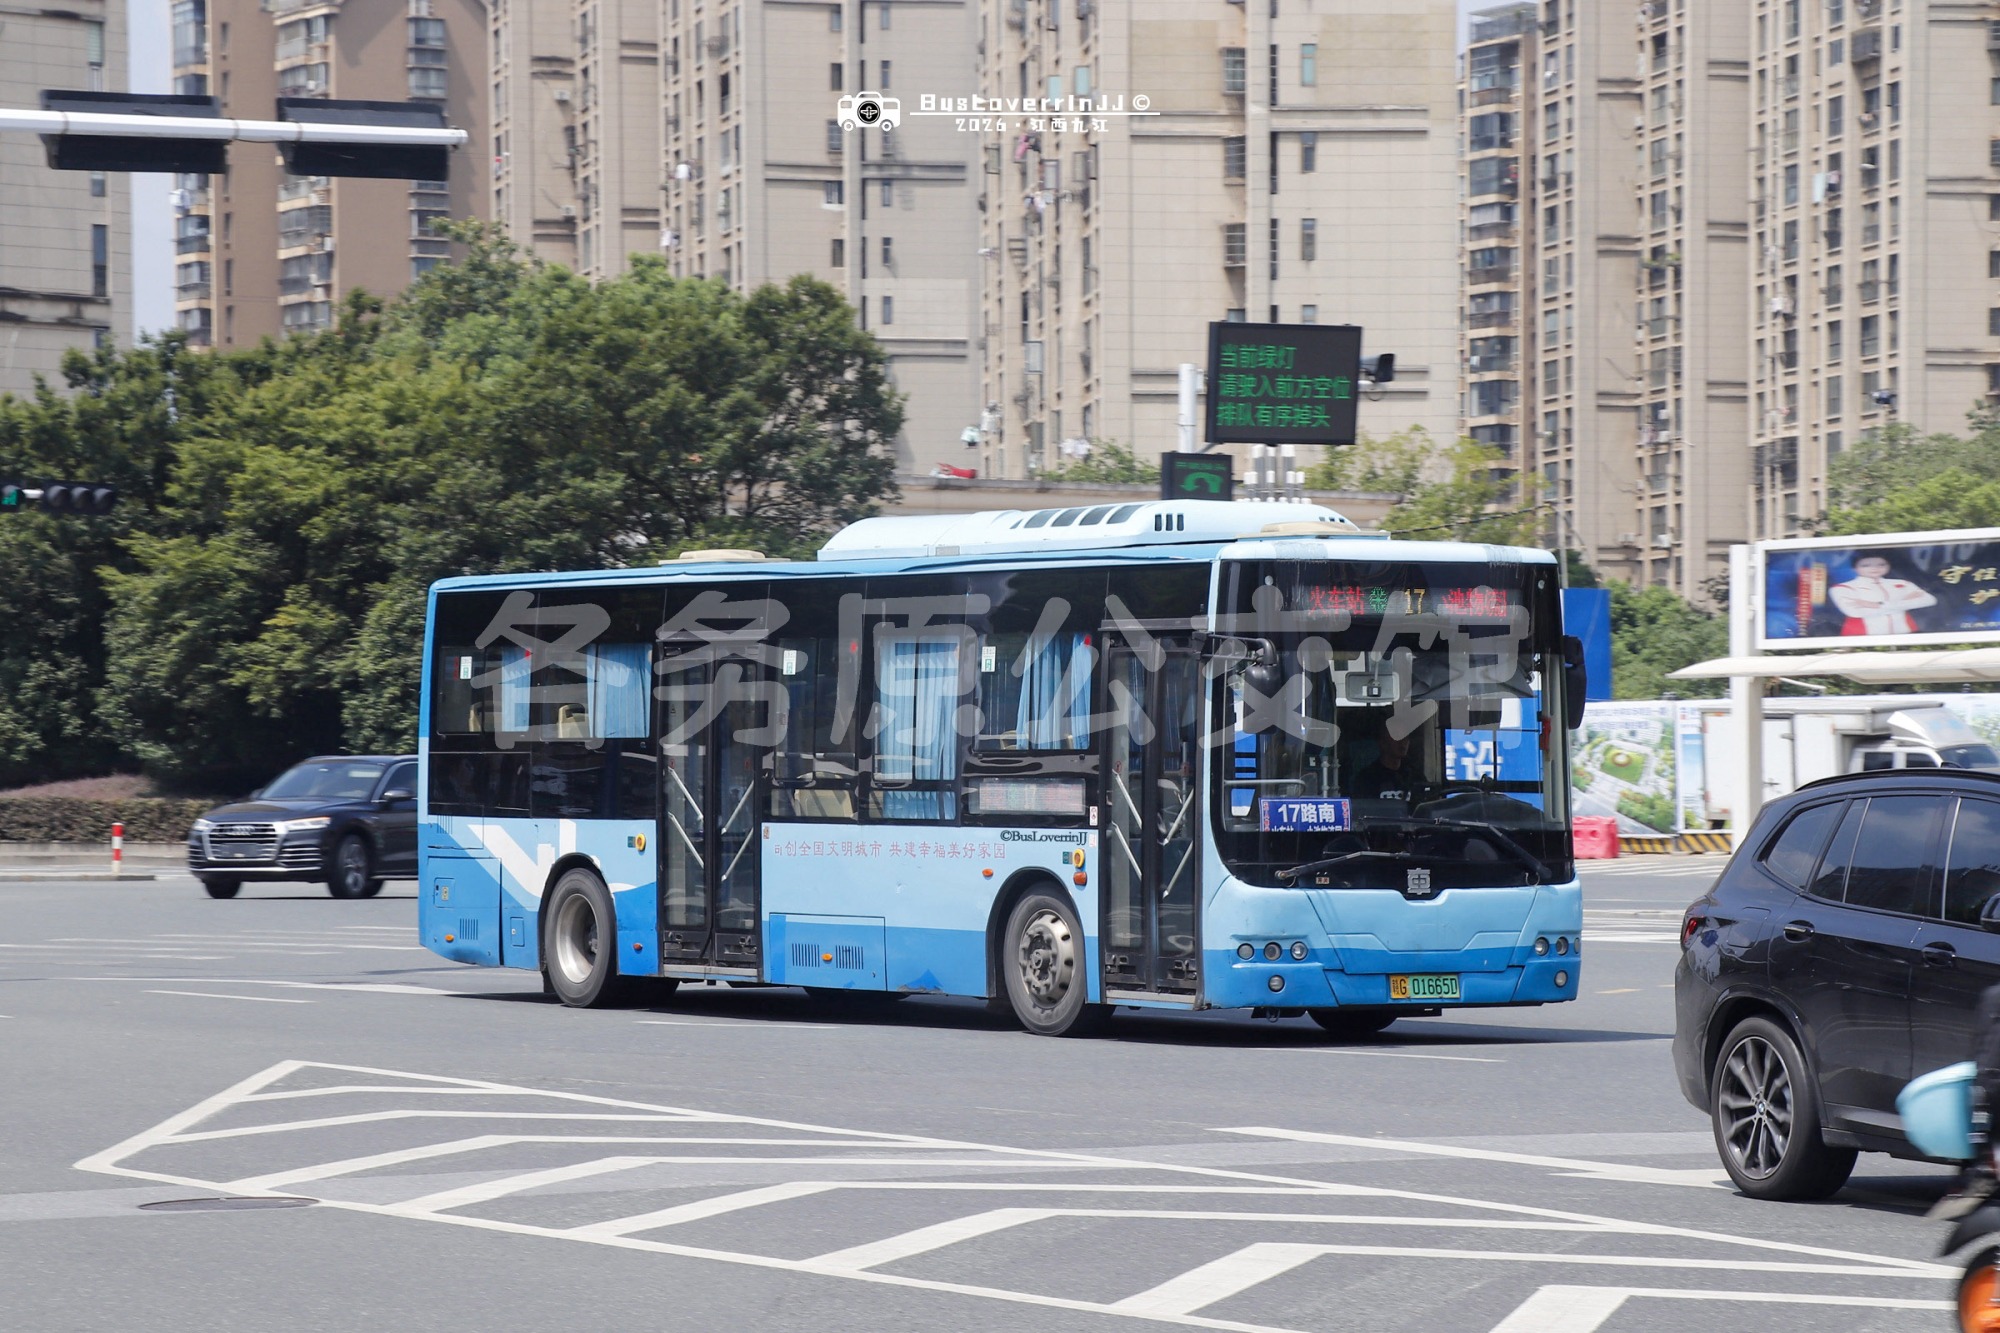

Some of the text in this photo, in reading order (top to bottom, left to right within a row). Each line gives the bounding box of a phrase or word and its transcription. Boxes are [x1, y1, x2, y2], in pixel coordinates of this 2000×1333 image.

[1220, 344, 1297, 370] 当前绿灯
[1218, 373, 1352, 400] 请驶入前方空位
[1216, 402, 1331, 428] 排队有序掉头
[1308, 586, 1365, 616] 火车站
[1405, 588, 1426, 615] 17
[1277, 803, 1335, 823] 17路南
[889, 840, 1006, 860] 共建幸福美好家园
[1412, 977, 1458, 996] 01665D
